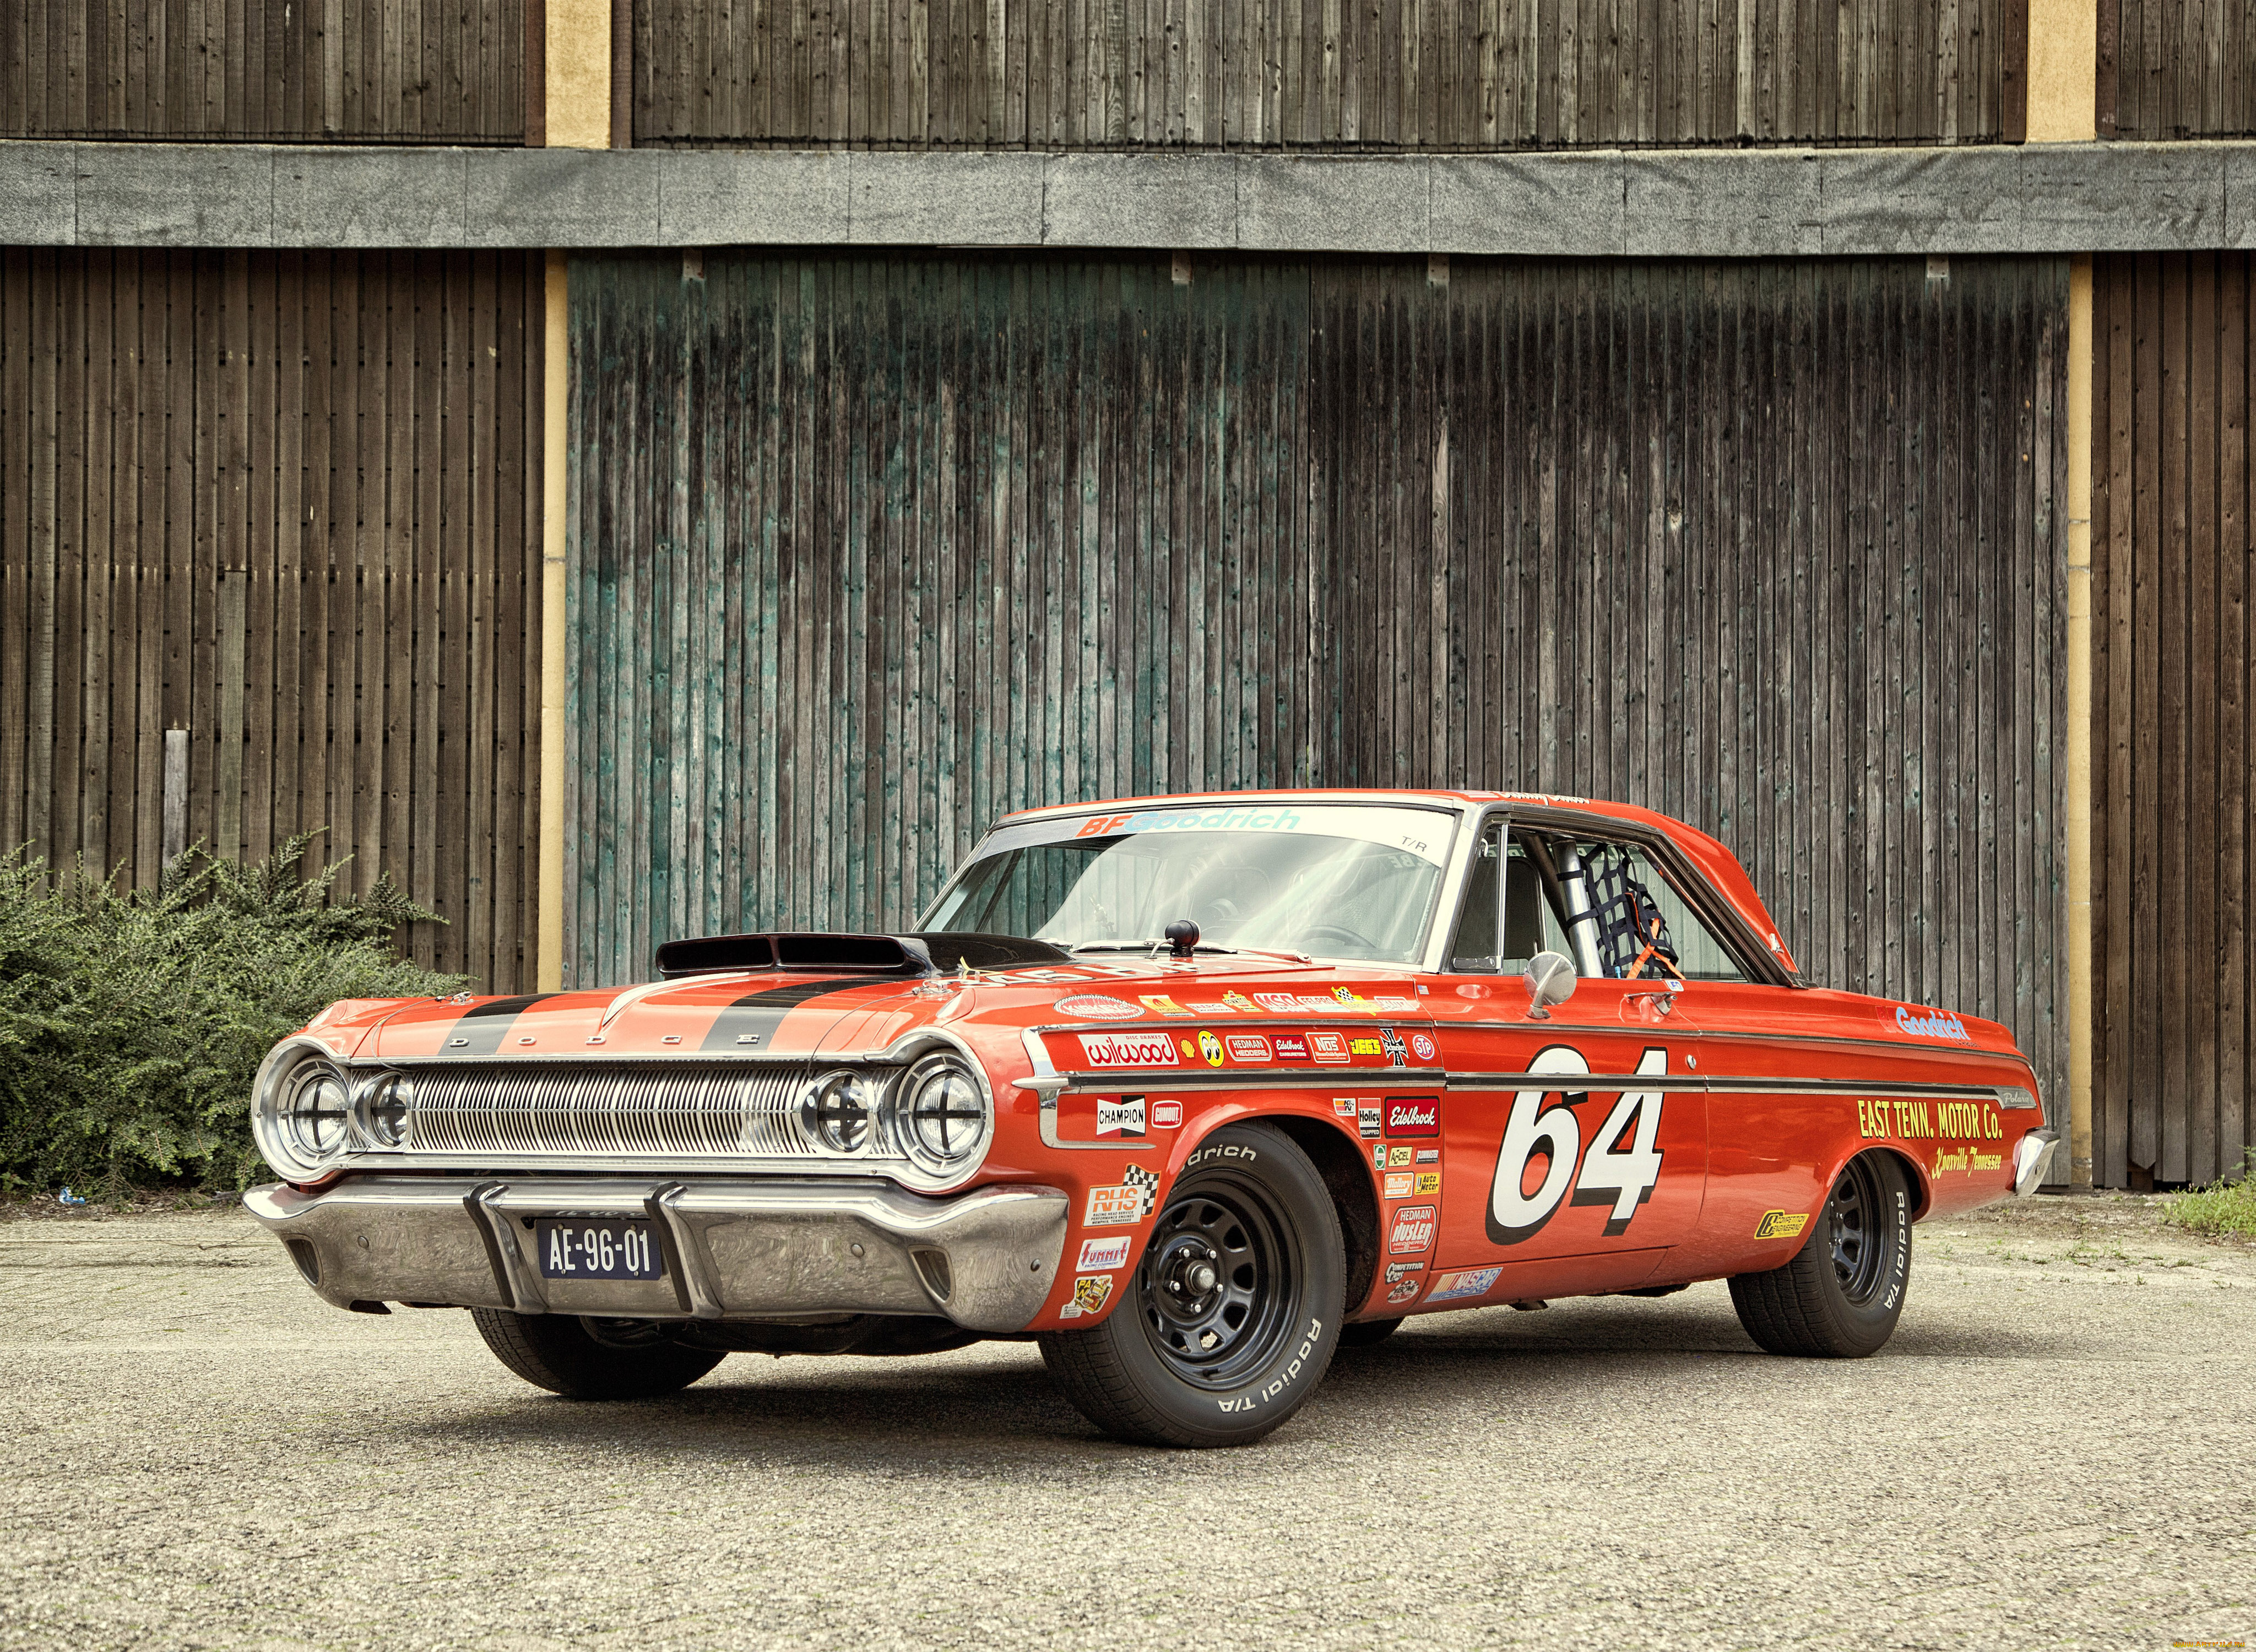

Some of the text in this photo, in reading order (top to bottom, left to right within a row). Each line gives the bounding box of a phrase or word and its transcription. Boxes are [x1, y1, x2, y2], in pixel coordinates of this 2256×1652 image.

[1075, 808, 1301, 838] BFGoodrich
[1402, 836, 1428, 852] T/R
[1255, 995, 1300, 1007] MSD
[449, 1034, 760, 1047] DODGE
[1231, 1039, 1264, 1049] HEDMAN
[1276, 1039, 1305, 1051] Edelbrock
[1314, 1035, 1340, 1051] NOS
[1351, 1038, 1381, 1055] JEG'S
[1415, 1037, 1432, 1055] STP
[1088, 1035, 1175, 1064] wilwood
[2003, 1092, 2030, 1104] Polara
[1099, 1108, 1144, 1124] CHAMPION
[1155, 1107, 1179, 1122] GUMOUT
[1359, 1110, 1380, 1126] Holley
[1390, 1105, 1435, 1127] Edelbrock
[1858, 1100, 2003, 1139] EAST TENN. MOTOR Co.
[1487, 1044, 1668, 1242] 64
[1180, 1144, 1256, 1172] drich
[1932, 1146, 2002, 1180] Knoxville Tennessee
[1387, 1176, 1412, 1189] Mallory
[1423, 1175, 1436, 1183] Auto
[1093, 1187, 1138, 1213] RHS
[1400, 1209, 1431, 1221] HEDMAN
[1391, 1221, 1433, 1246] HUSLER
[550, 1229, 650, 1272] AE-96-01
[1884, 1192, 1906, 1309] Radial T/A
[1455, 1270, 1499, 1289] NASCAR
[1217, 1318, 1322, 1412] Radial T/A
